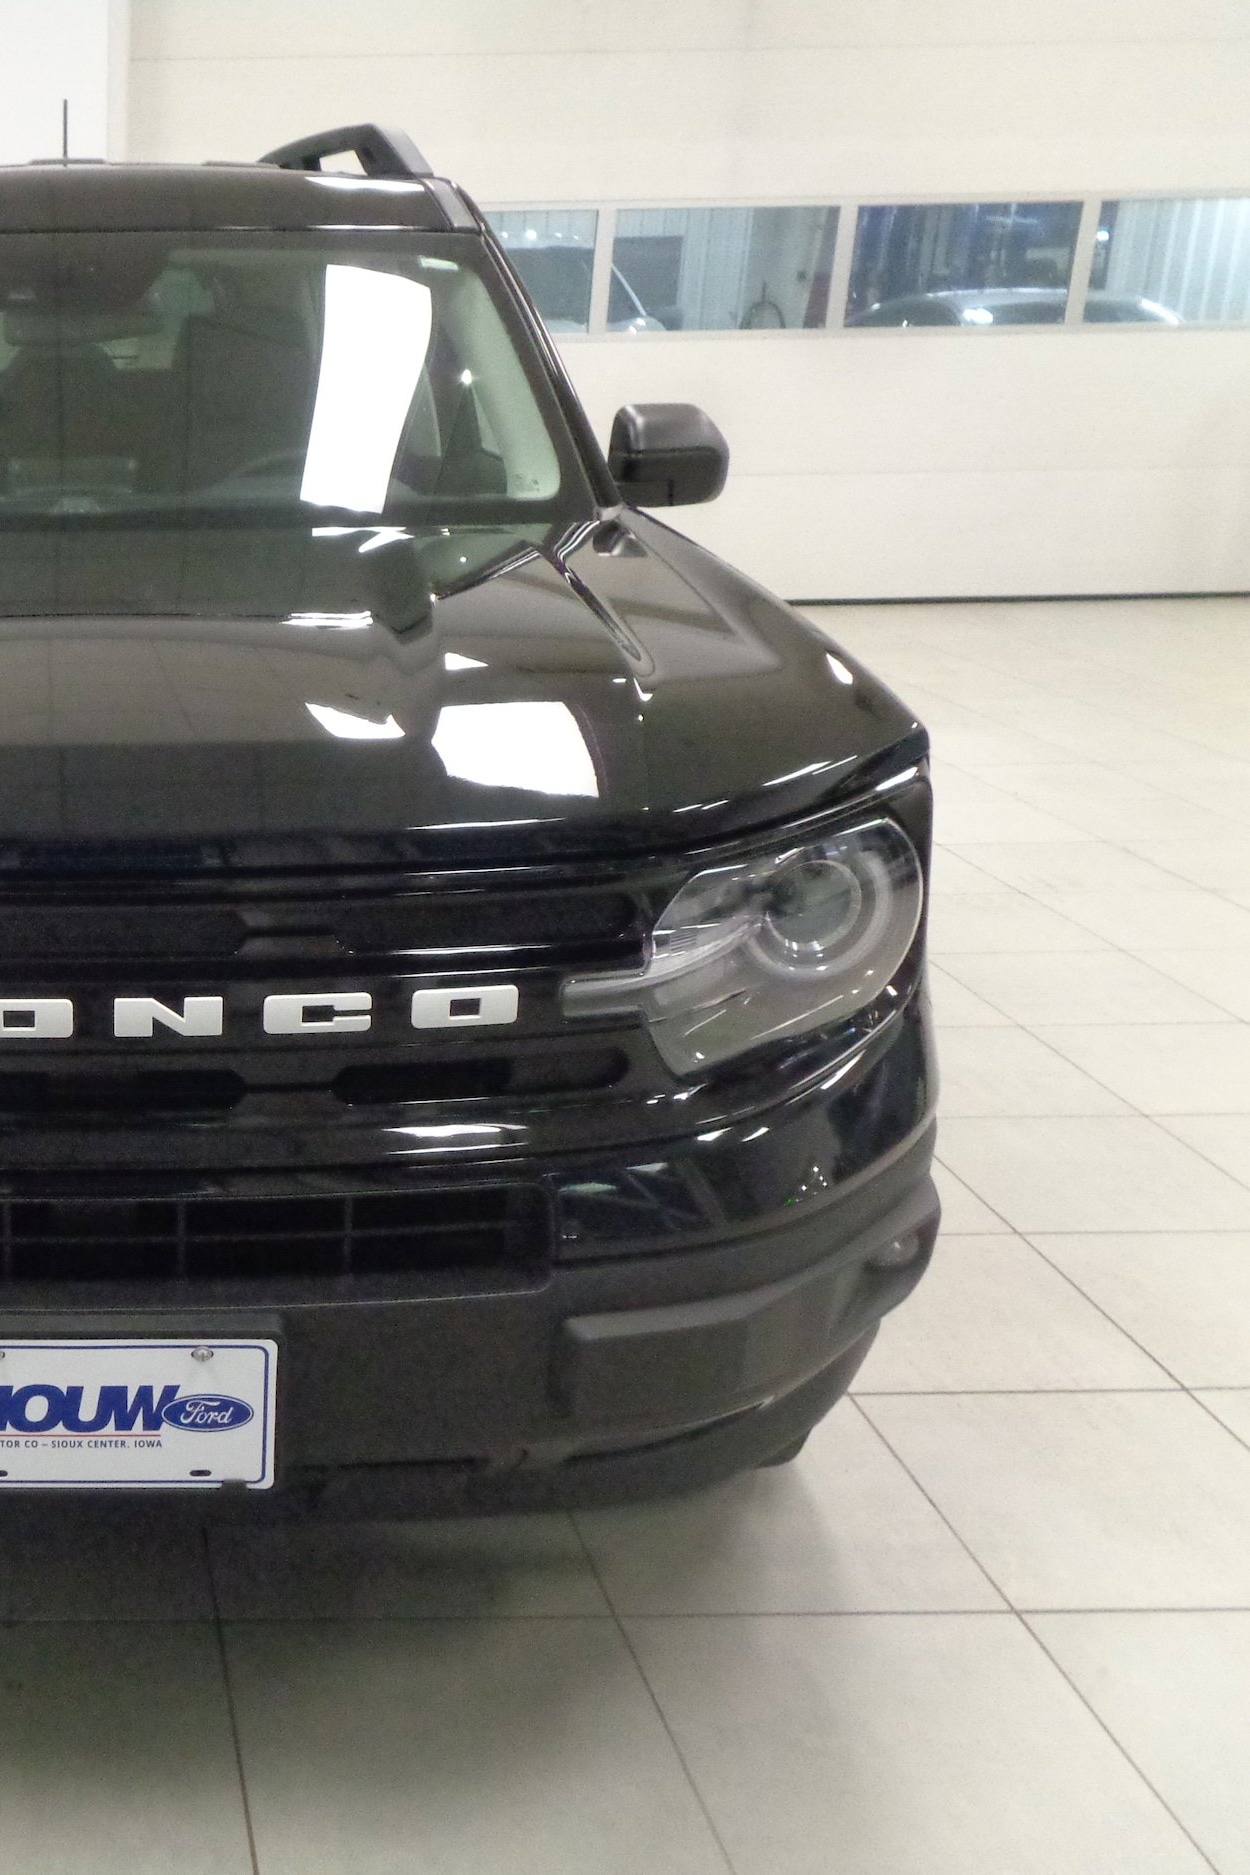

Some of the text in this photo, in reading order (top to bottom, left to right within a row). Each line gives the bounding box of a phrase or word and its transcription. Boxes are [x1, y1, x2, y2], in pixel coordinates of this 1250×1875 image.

[179, 1400, 233, 1426] Ford
[24, 1440, 39, 1449] CO
[51, 1440, 83, 1449] SIOUX
[134, 1439, 163, 1448] IOWA
